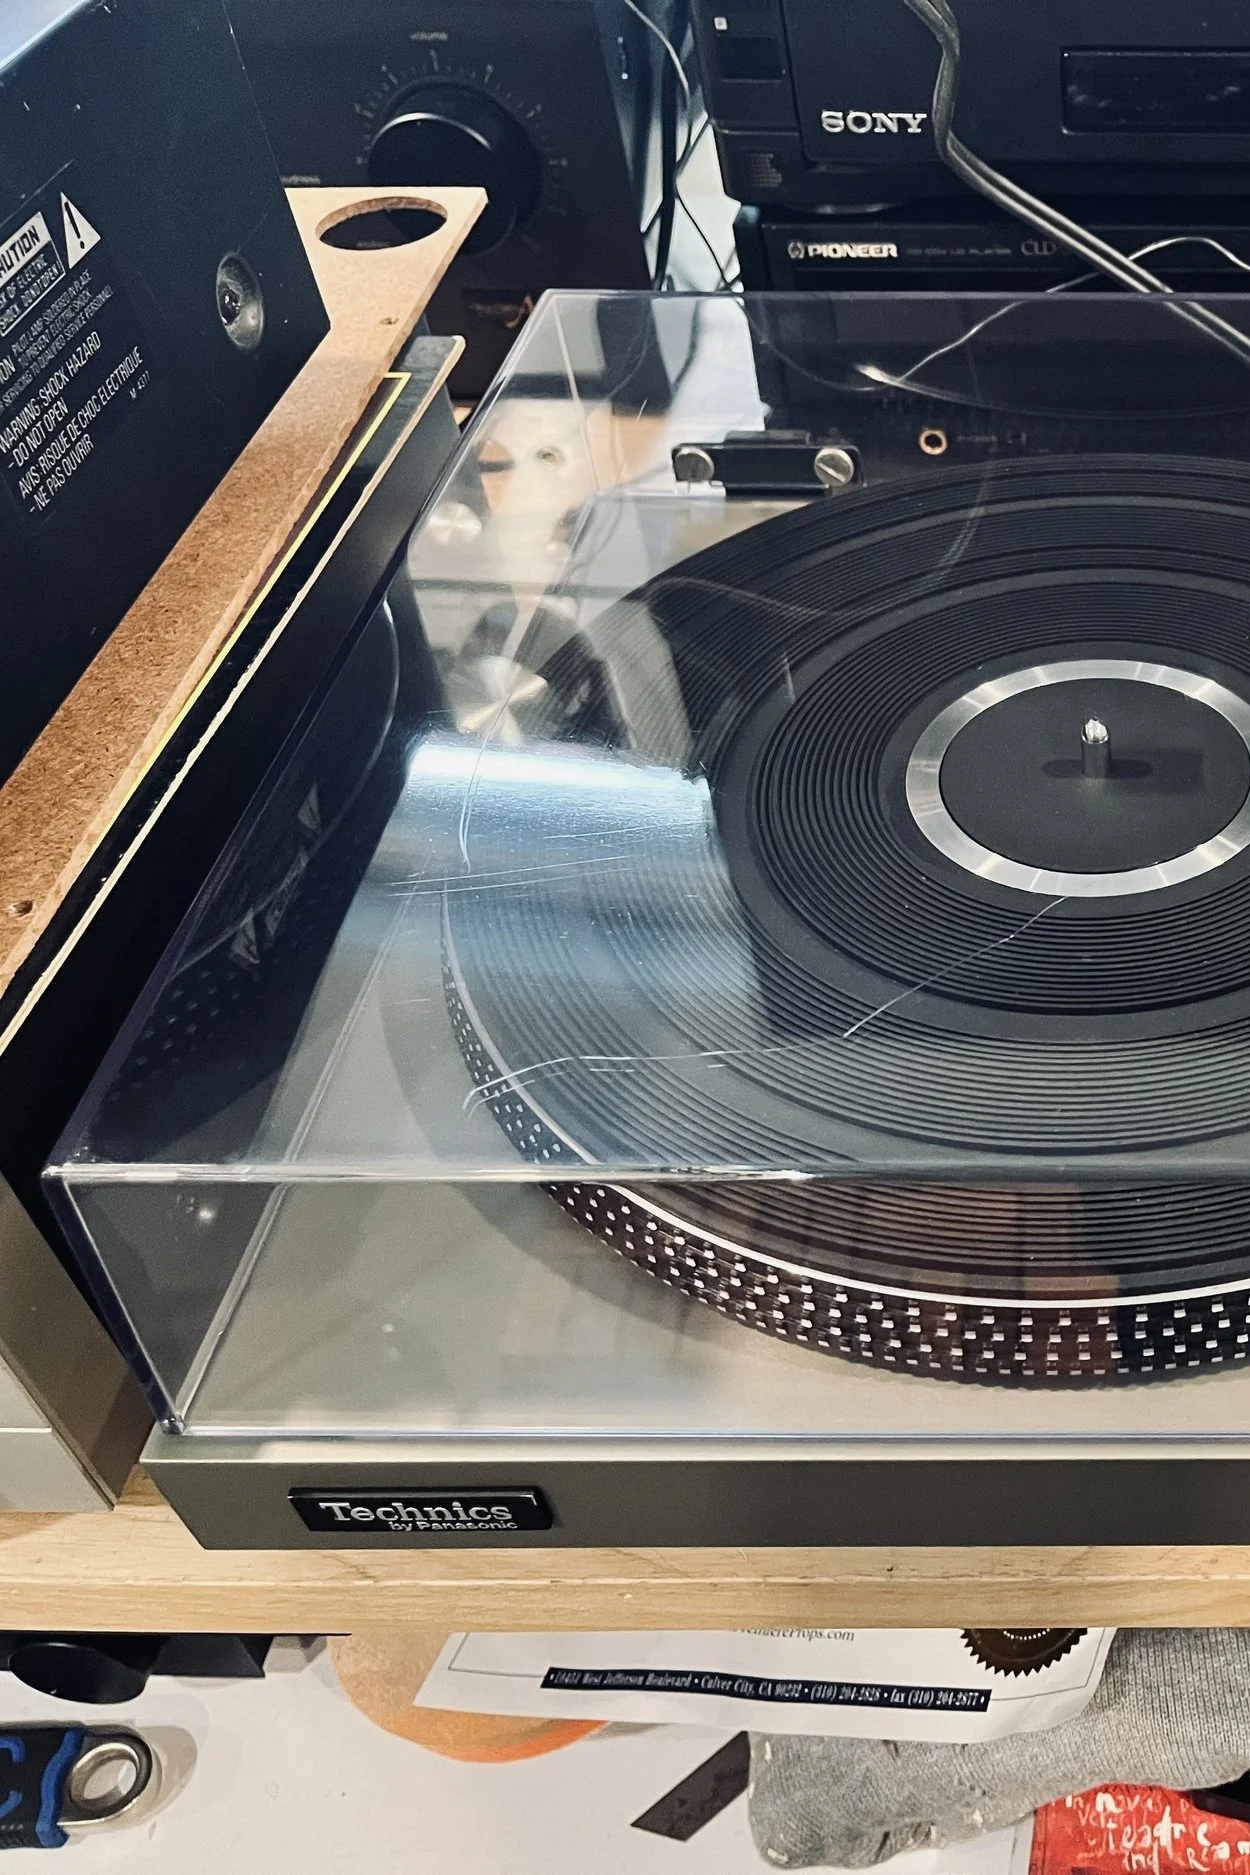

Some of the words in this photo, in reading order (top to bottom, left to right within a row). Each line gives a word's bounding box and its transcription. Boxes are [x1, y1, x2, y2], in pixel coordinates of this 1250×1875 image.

[821, 110, 927, 133] SONY
[0, 224, 40, 278] AUTION
[807, 244, 898, 258] PIONEER
[39, 366, 70, 407] SHOCK
[65, 331, 101, 377] HAZARD
[26, 421, 46, 452] NOT
[43, 397, 69, 432] OPEN
[38, 430, 71, 475] RISQUE
[66, 418, 82, 442] DE
[77, 395, 101, 429] CHOC
[97, 346, 143, 407] ELECTRIQUE
[46, 467, 66, 496] PAS
[62, 433, 94, 477] OUVRIR
[319, 1501, 513, 1521] Technics
[390, 1520, 413, 1532] by
[419, 1521, 518, 1530] Panasonic
[603, 1673, 643, 1685] Jefferson
[645, 1673, 692, 1688] Boulevard
[700, 1675, 732, 1690] Culver
[734, 1679, 755, 1696] City,
[758, 1683, 772, 1696] CA
[810, 1684, 837, 1701] (310)
[890, 1688, 906, 1703] fax
[907, 1690, 934, 1706] (310)
